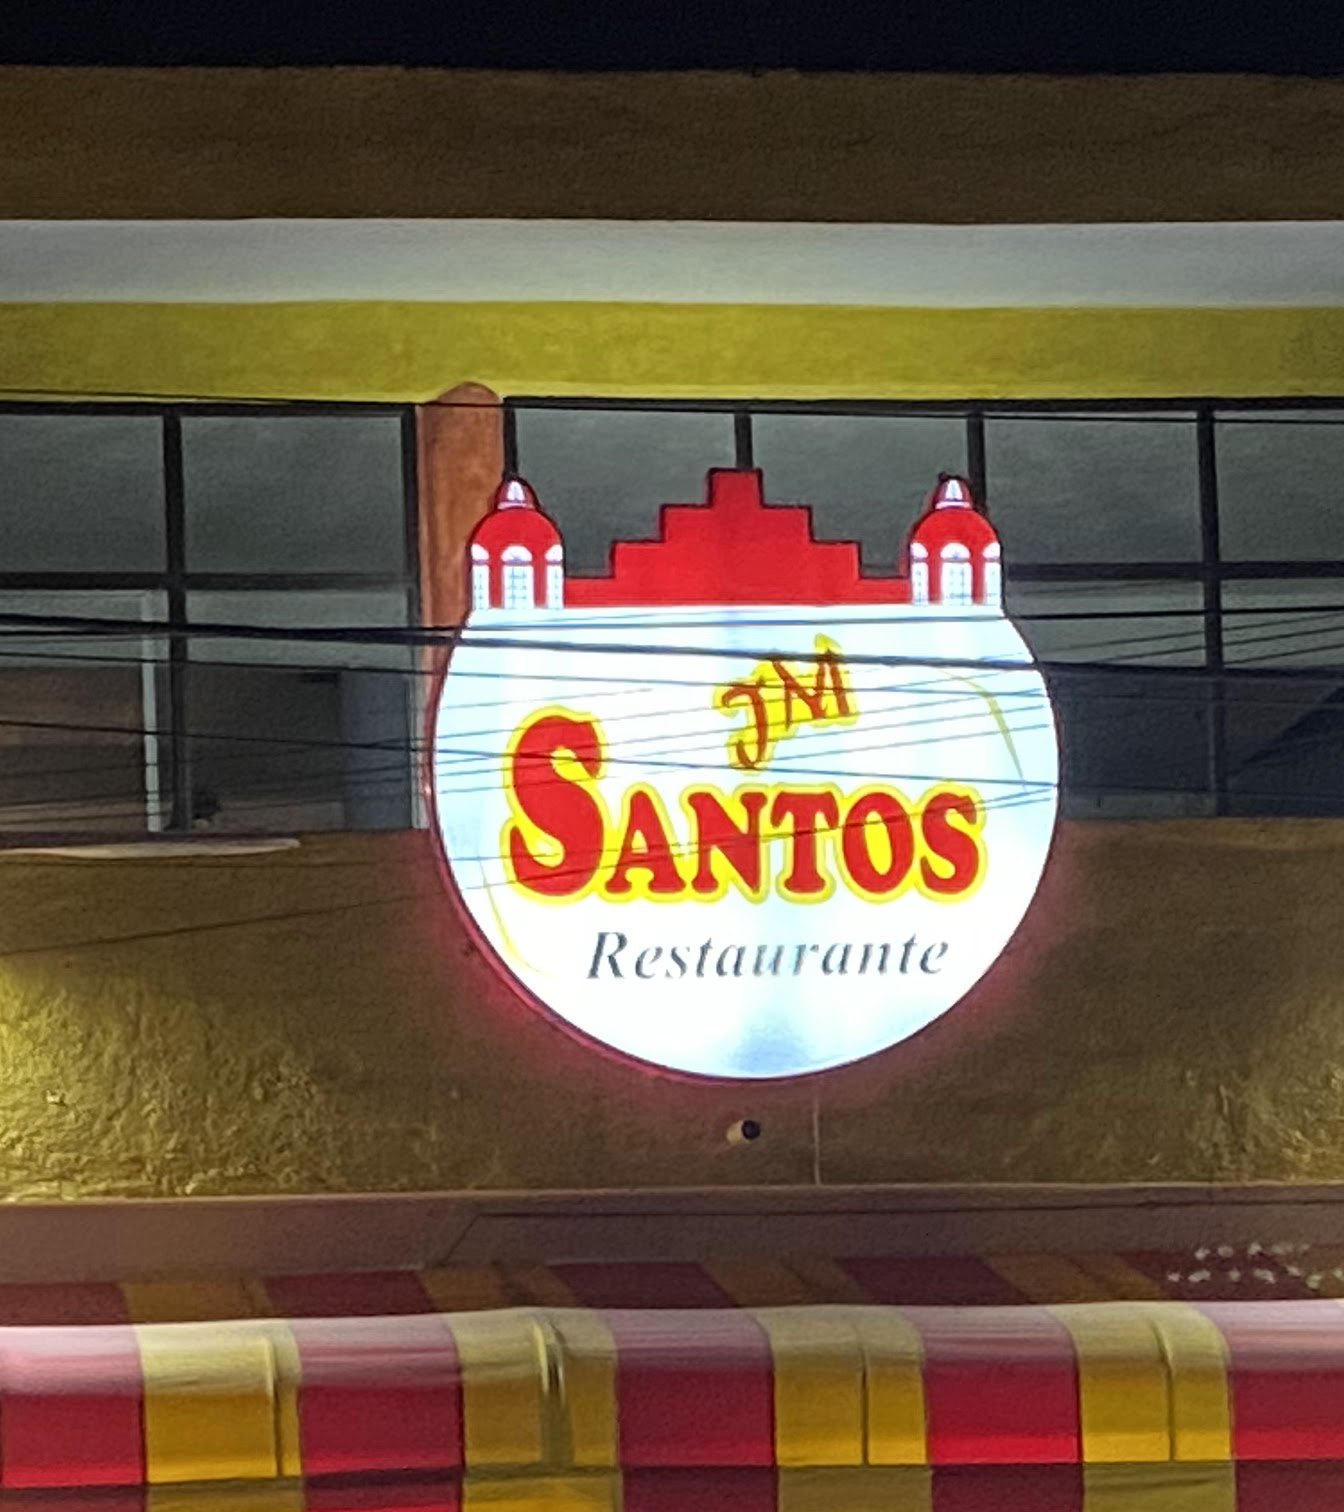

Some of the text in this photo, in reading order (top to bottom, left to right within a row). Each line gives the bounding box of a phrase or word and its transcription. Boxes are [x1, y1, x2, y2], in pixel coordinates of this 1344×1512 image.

[716, 638, 857, 771] JM
[504, 710, 985, 900] SANTOS
[587, 930, 950, 980] Restaurante
